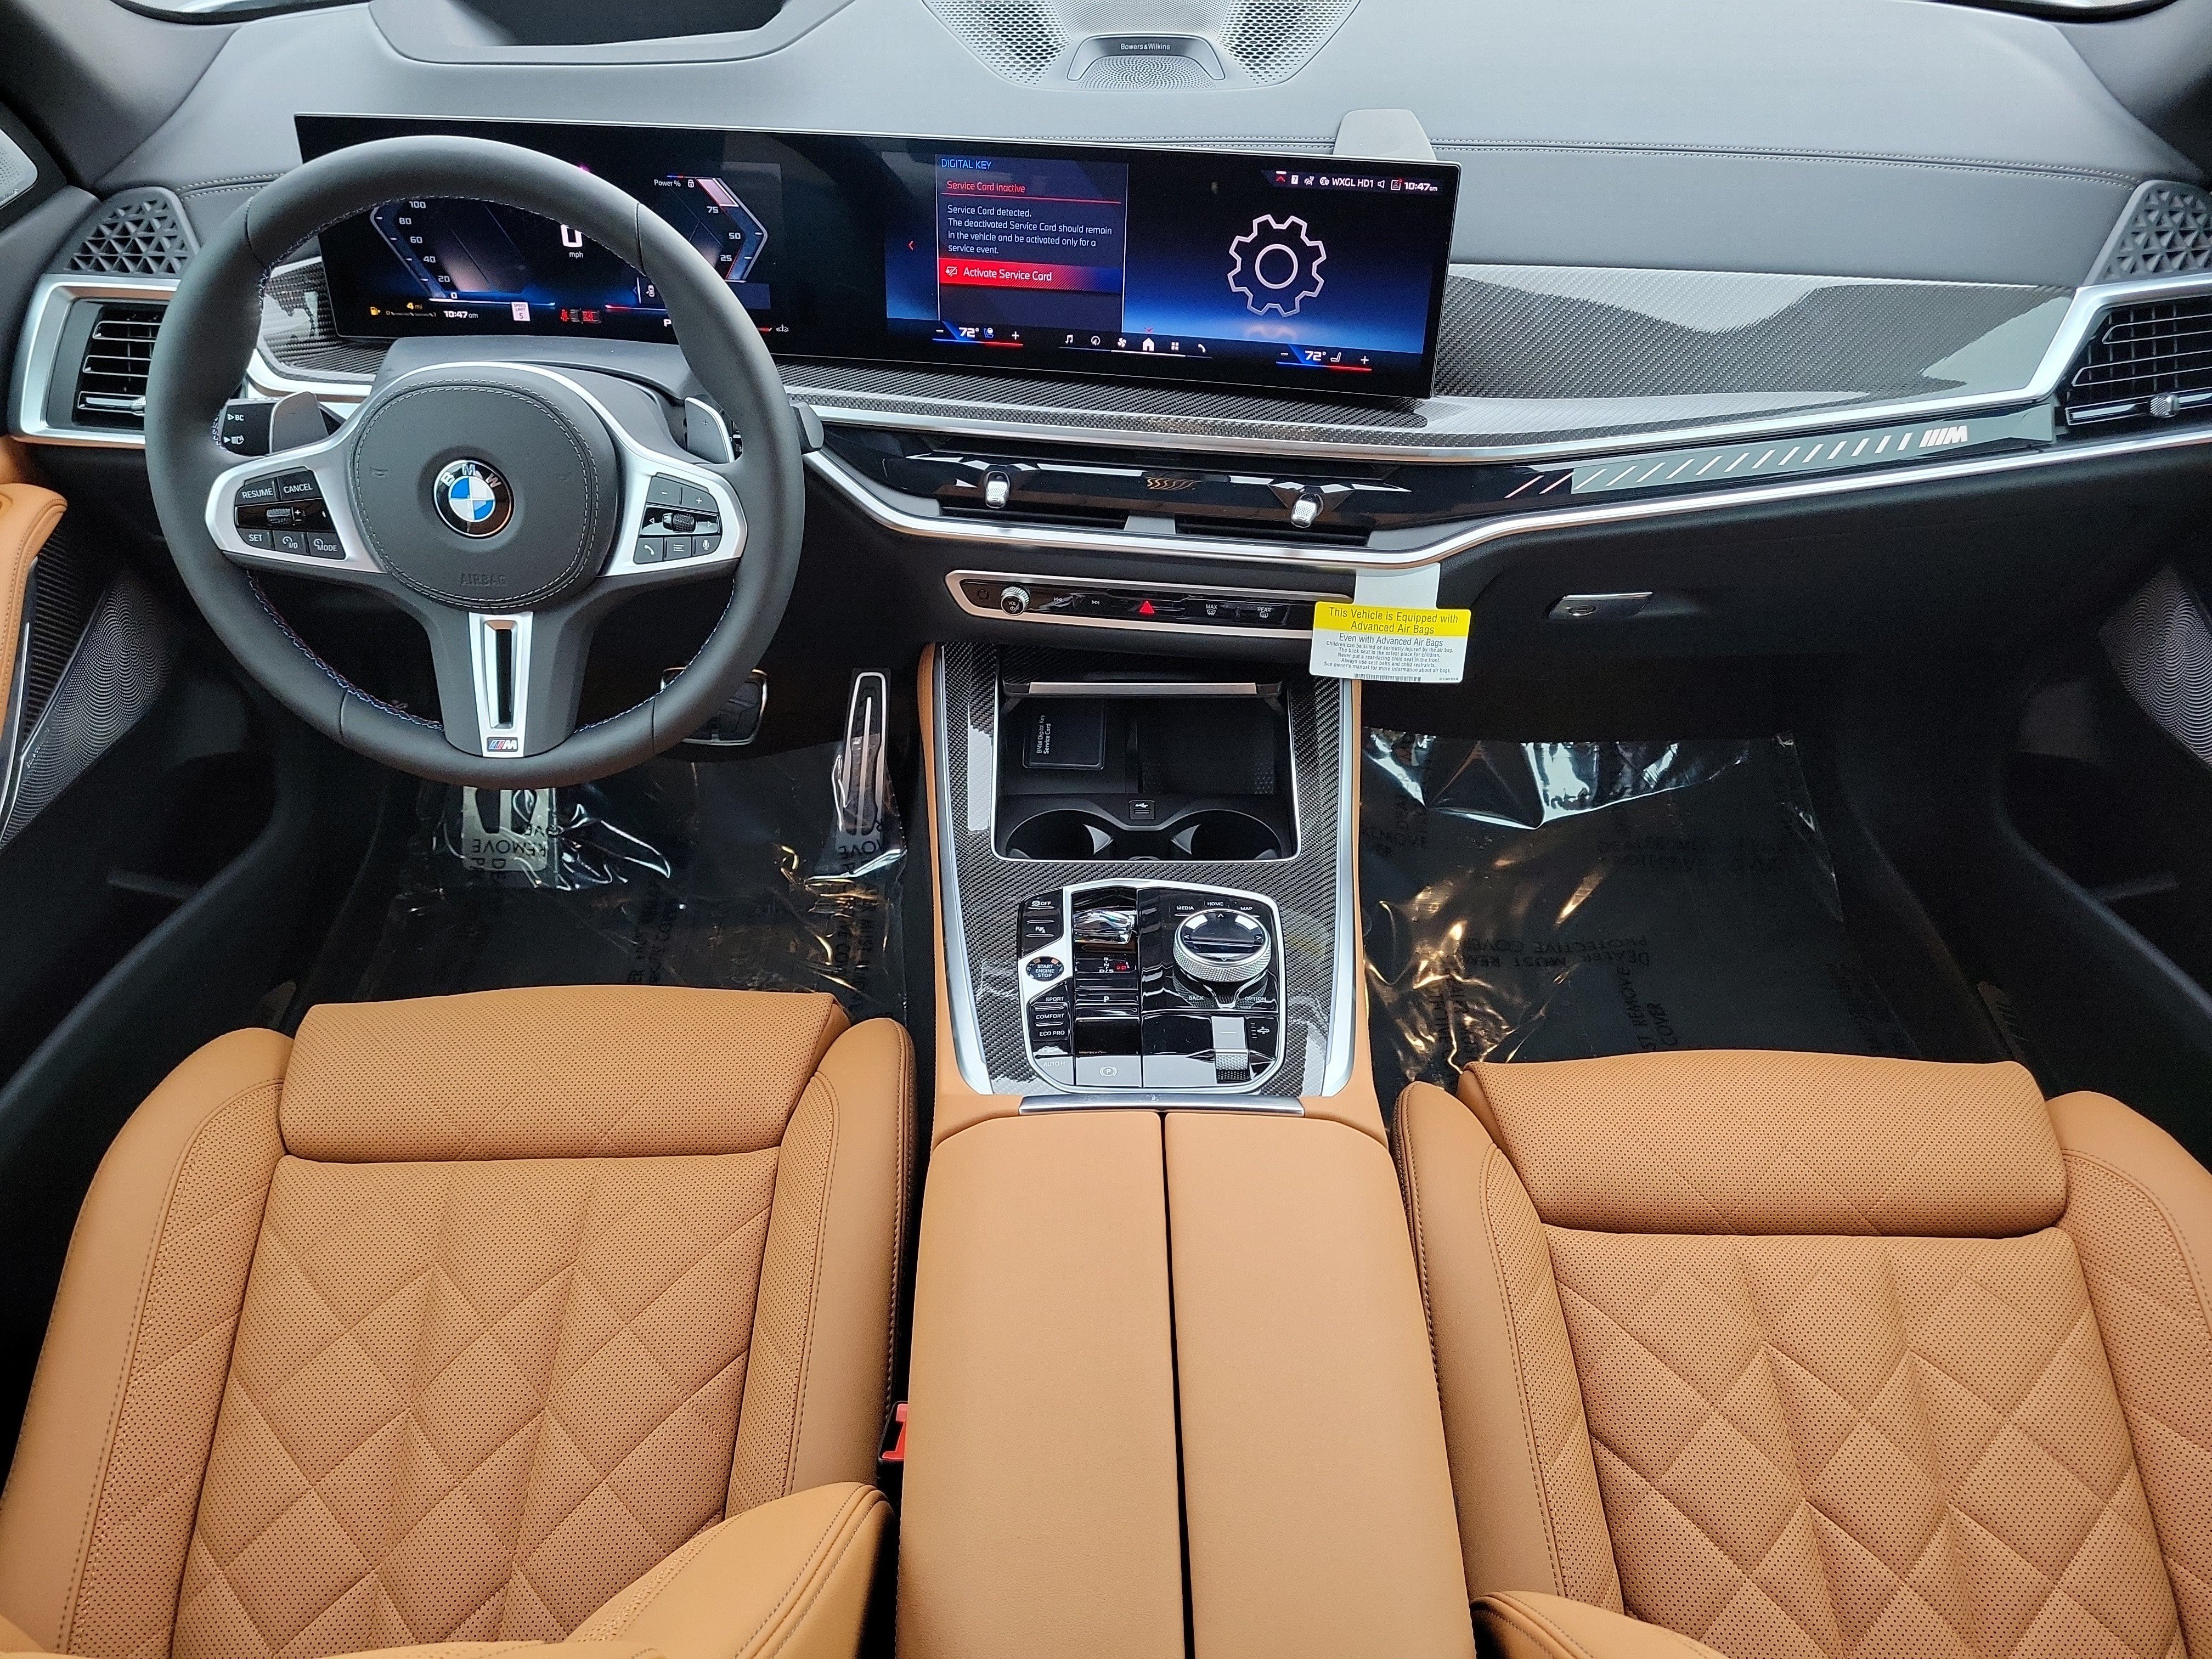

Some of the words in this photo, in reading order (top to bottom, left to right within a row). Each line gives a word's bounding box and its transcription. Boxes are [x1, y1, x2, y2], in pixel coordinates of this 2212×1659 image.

[941, 159, 973, 168] DIGITAL
[975, 160, 992, 170] KEY
[946, 180, 975, 190] Service
[977, 182, 995, 191] Card
[1331, 177, 1356, 188] WXGL
[1357, 179, 1374, 188] HD1
[947, 205, 975, 215] Service
[977, 206, 995, 216] Card
[996, 207, 1032, 217] detected.
[947, 218, 962, 227] The
[964, 219, 1008, 229] deactivated
[1009, 221, 1037, 230] Service
[1039, 222, 1057, 232] Card
[1058, 224, 1084, 233] should
[1086, 226, 1112, 235] remain
[560, 224, 583, 247] 0
[948, 230, 955, 240] in
[957, 231, 969, 240] the
[970, 232, 996, 241] vehicle
[998, 234, 1012, 242] and
[1015, 234, 1024, 243] be
[1026, 235, 1060, 245] activated
[1062, 237, 1079, 247] only
[1079, 237, 1090, 247] for
[948, 244, 974, 253] service
[963, 267, 997, 279] Activate
[998, 269, 1030, 281] Service
[1032, 270, 1052, 283] Card
[242, 488, 274, 499] RESUME
[284, 483, 314, 494] CANCEL
[249, 534, 263, 542] SET
[1329, 607, 1347, 617] This
[1351, 608, 1383, 620] Vehicle
[1386, 611, 1393, 621] is
[1396, 612, 1437, 624] Equipped
[1440, 614, 1458, 623] with
[1351, 620, 1395, 633] Advanced
[1397, 624, 1411, 633] Air
[1413, 624, 1435, 636] Bags
[1339, 633, 1357, 642] Even
[1358, 635, 1374, 644] with
[1376, 636, 1412, 646] Advanced
[1413, 638, 1424, 646] Air
[1426, 639, 1443, 648] Bags
